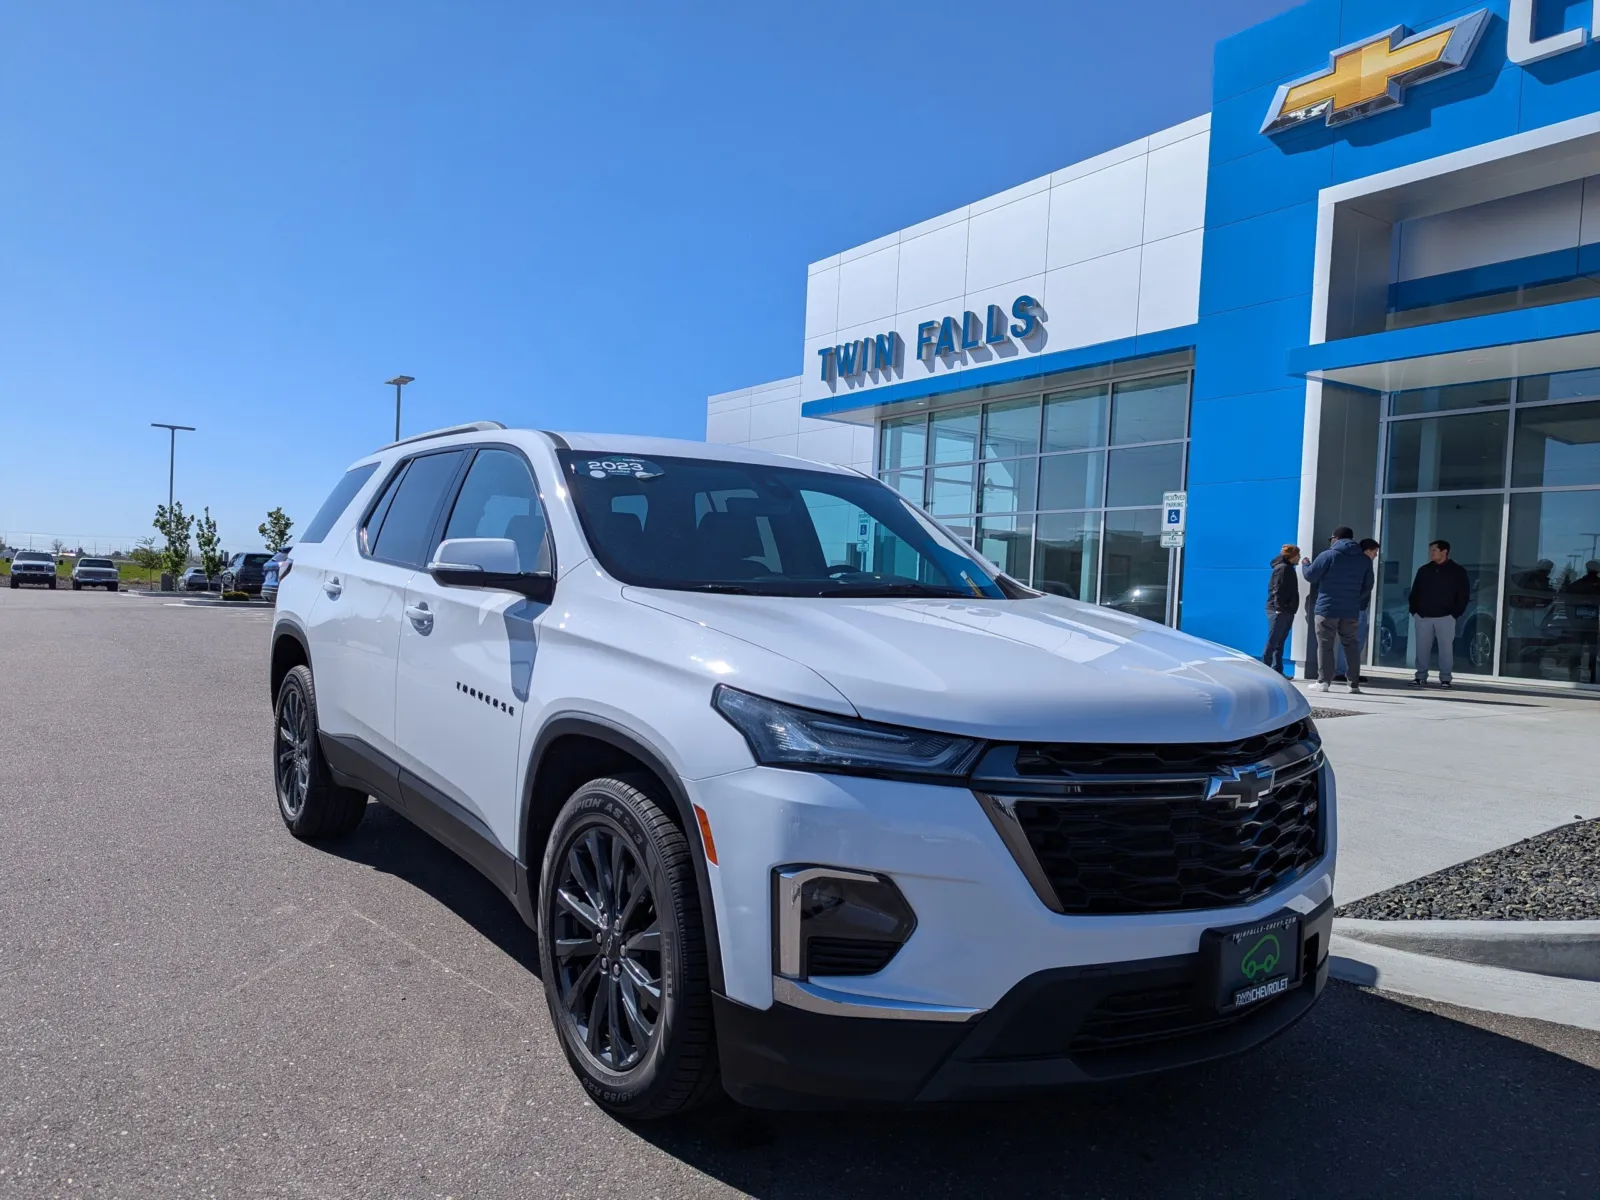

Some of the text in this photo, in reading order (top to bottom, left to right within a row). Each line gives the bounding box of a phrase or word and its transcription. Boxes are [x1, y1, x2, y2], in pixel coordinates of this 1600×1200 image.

[818, 295, 1036, 381] TWIN FALLS
[587, 461, 644, 471] 2023
[456, 681, 515, 717] TRAVERSE
[604, 803, 623, 819] AS
[1251, 977, 1289, 1001] CHEVROLET
